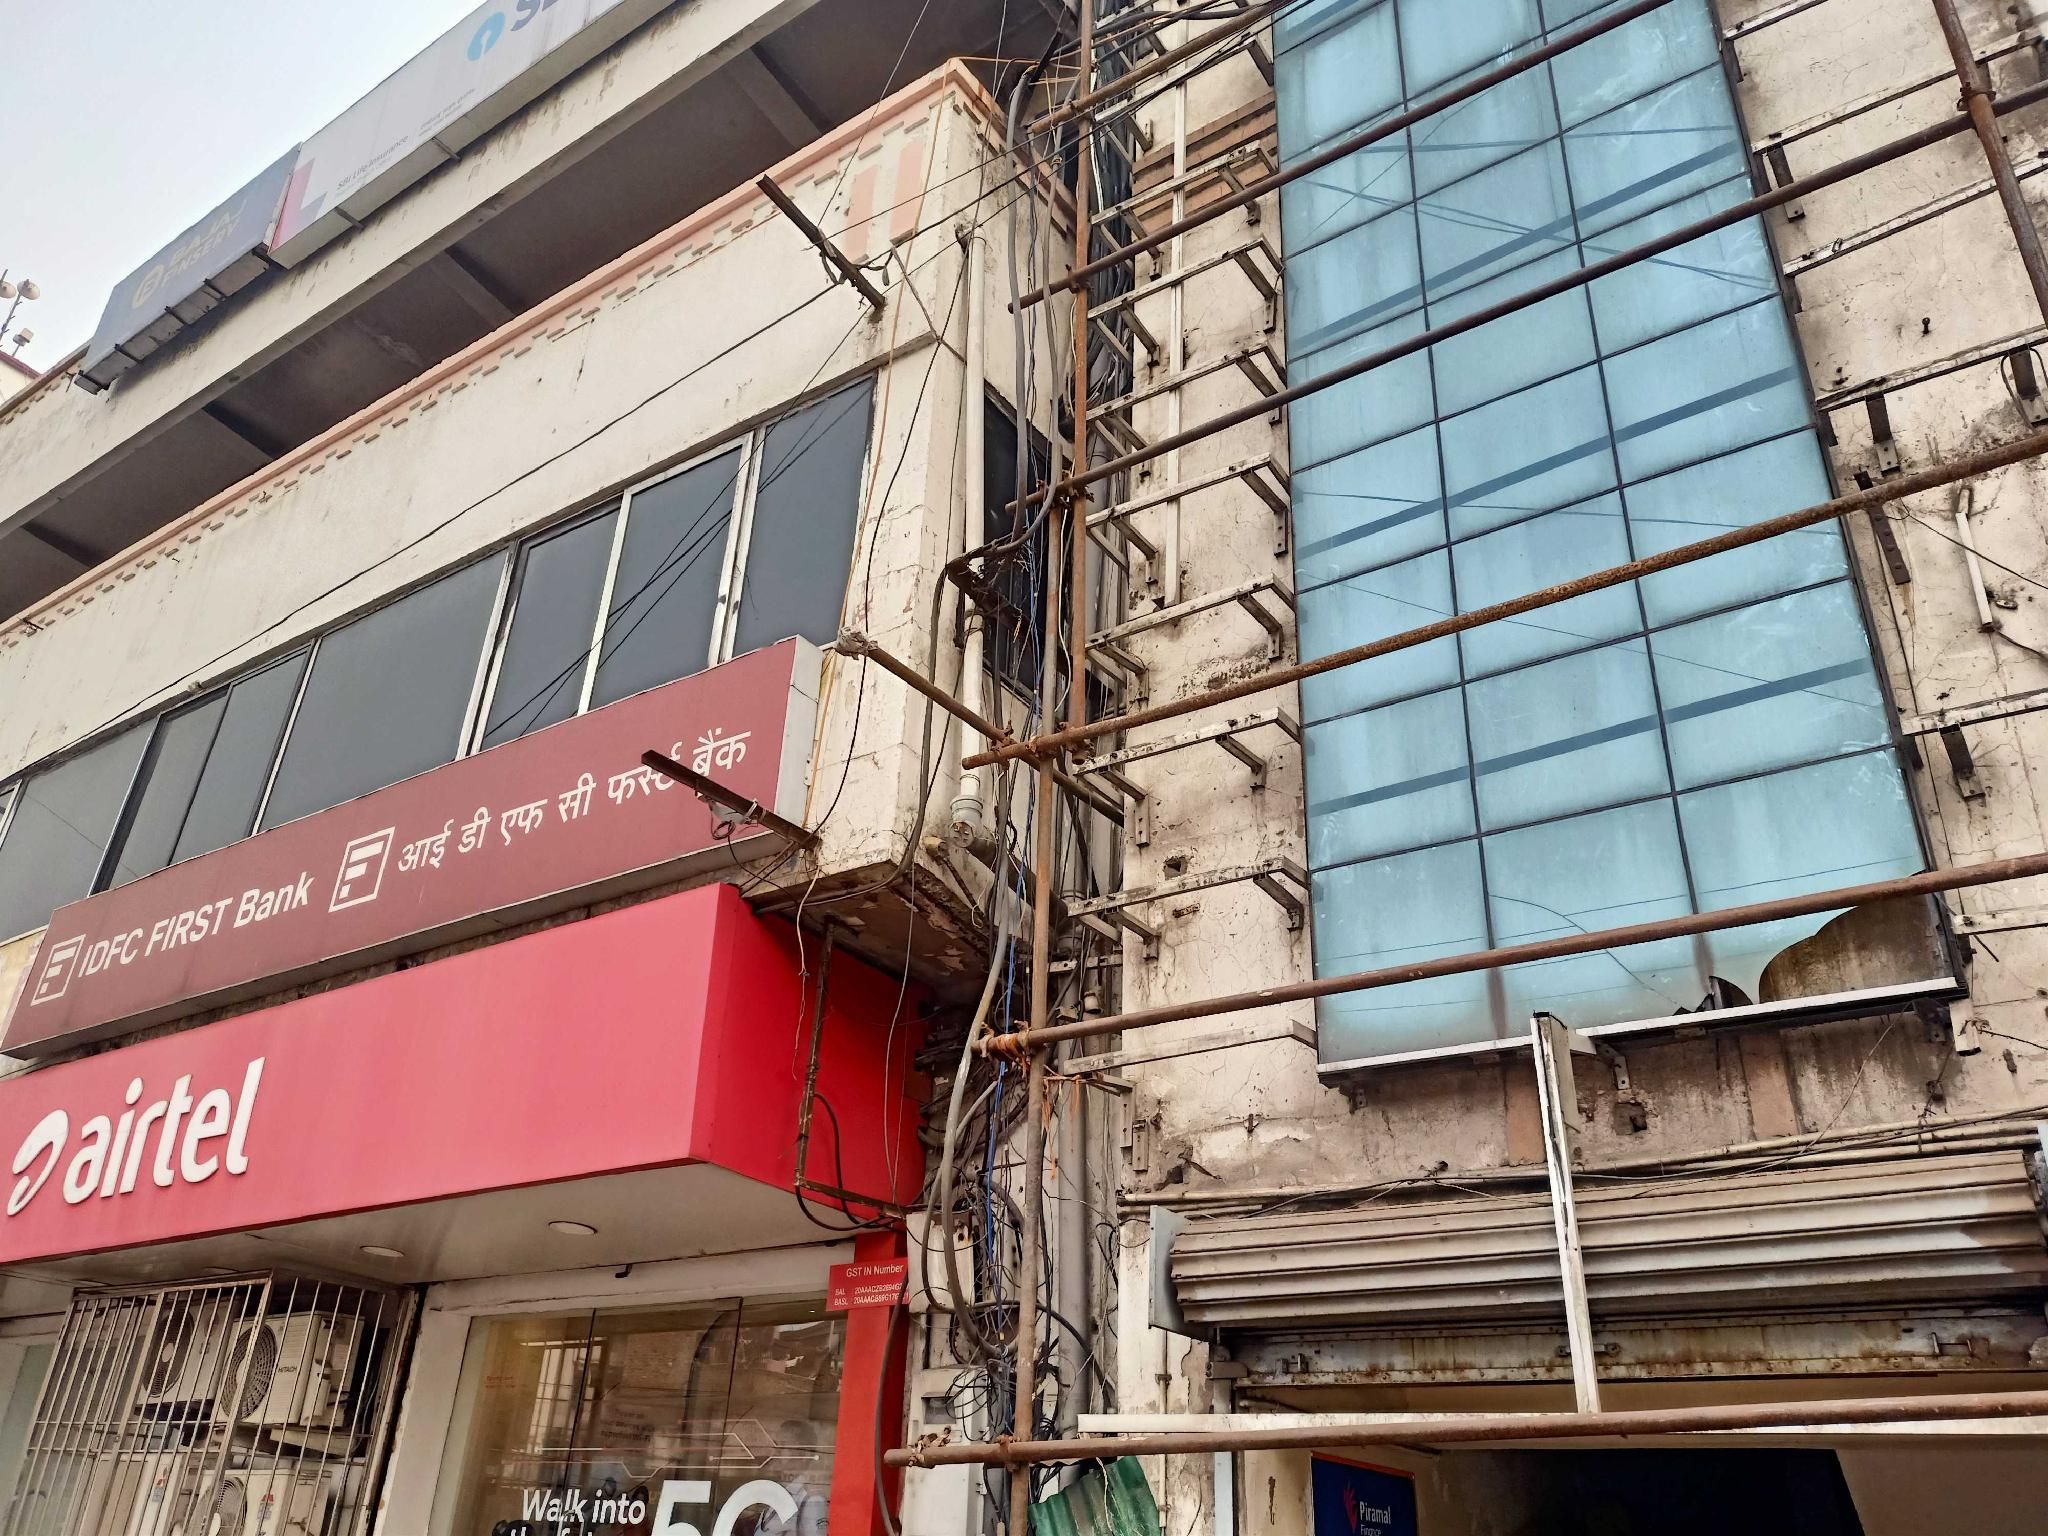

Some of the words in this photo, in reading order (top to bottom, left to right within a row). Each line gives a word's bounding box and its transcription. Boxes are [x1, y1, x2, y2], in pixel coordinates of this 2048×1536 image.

[398, 819, 454, 872] आई
[458, 807, 492, 853] डी
[500, 799, 548, 846] एफ
[558, 772, 596, 823] सी
[692, 727, 752, 777] बैंक
[78, 928, 143, 978] IDFC
[144, 897, 234, 957] FIRST
[233, 871, 315, 929] Bank
[63, 1056, 266, 1205] airtel
[846, 1267, 862, 1278] GST
[863, 1266, 872, 1276] IN
[873, 1264, 904, 1275] Number
[522, 1488, 588, 1523] Walk
[592, 1488, 646, 1525] into
[1360, 1501, 1391, 1525] Piramal
